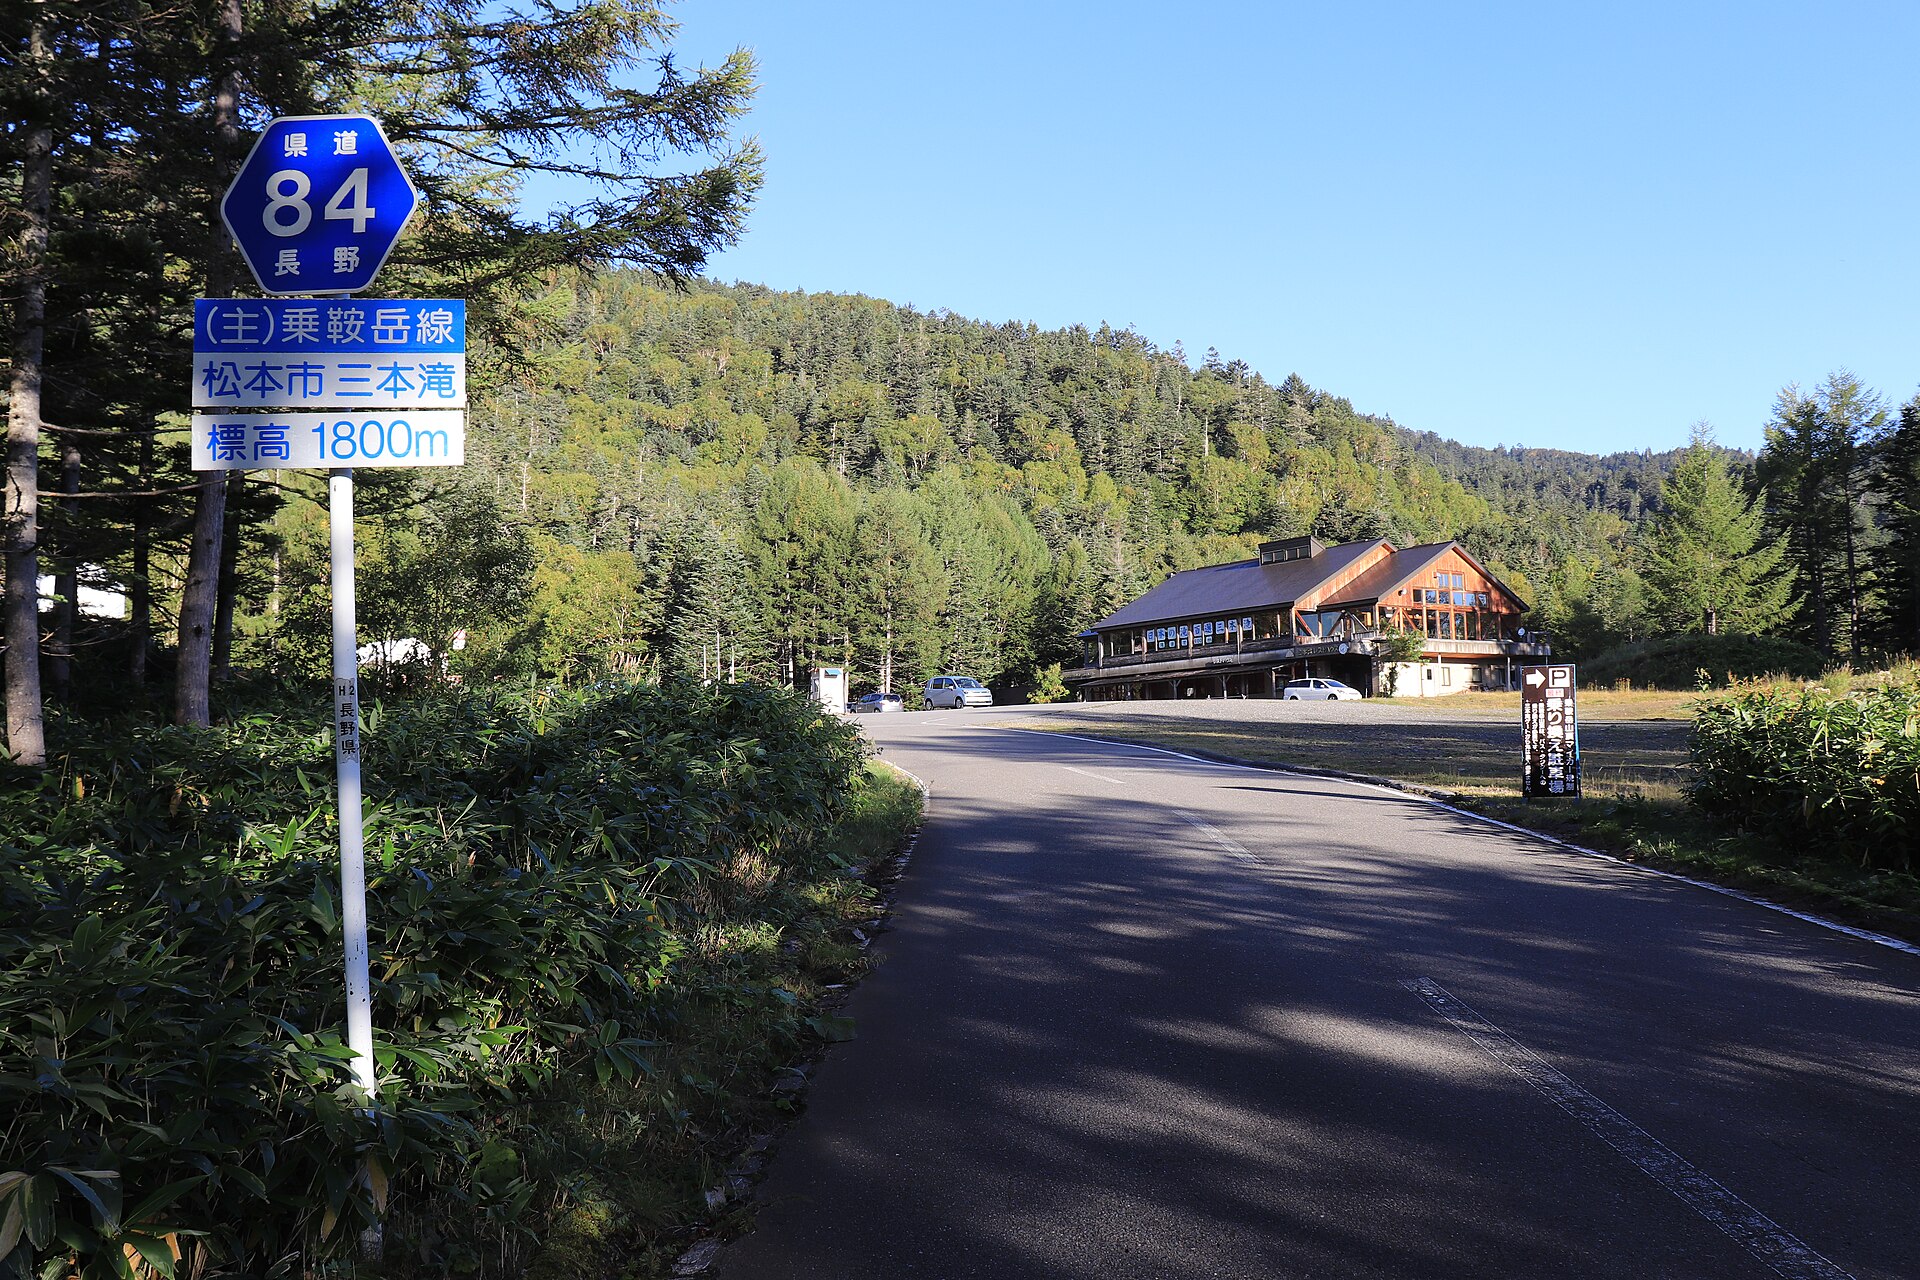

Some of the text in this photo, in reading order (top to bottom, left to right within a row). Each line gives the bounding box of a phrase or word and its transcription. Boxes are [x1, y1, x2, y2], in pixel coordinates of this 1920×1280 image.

[262, 167, 376, 237] 84
[274, 246, 361, 276] 長野
[206, 419, 449, 461] 標高 1800m
[1552, 669, 1567, 686] P
[340, 702, 357, 755] 長野県
